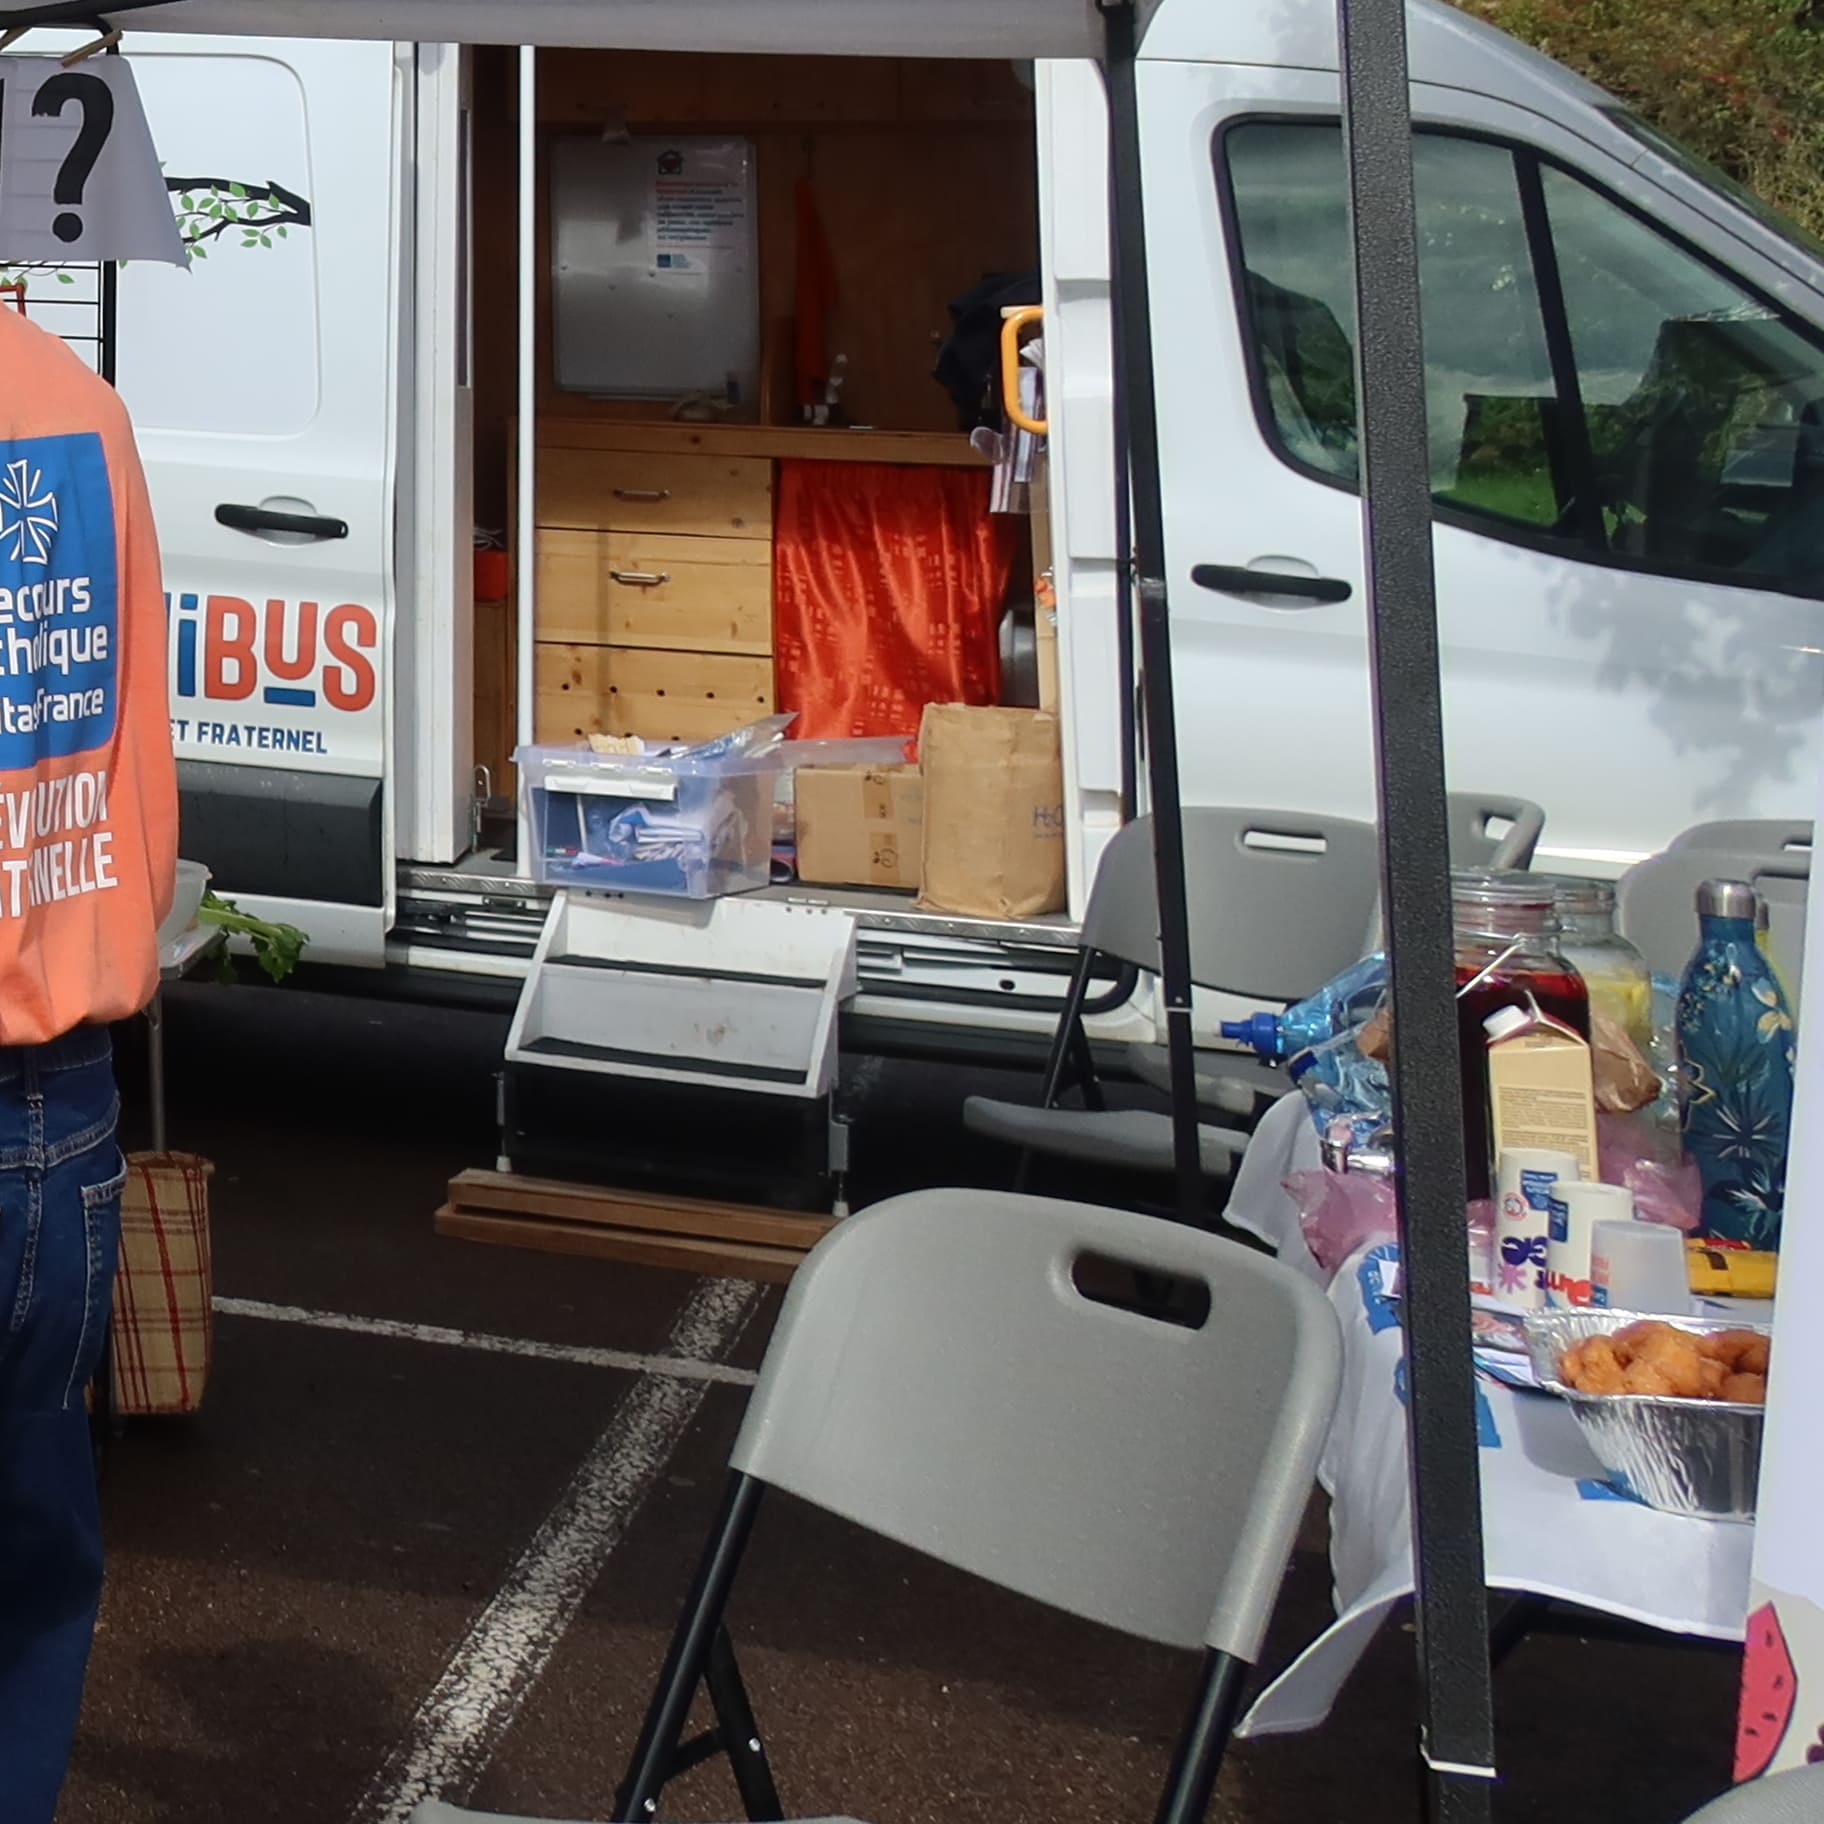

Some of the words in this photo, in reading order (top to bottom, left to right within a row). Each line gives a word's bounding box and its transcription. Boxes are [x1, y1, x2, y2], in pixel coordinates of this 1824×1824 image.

[31, 71, 117, 243] ?
[163, 592, 378, 713] iBUS
[196, 720, 328, 754] FRATERNEL
